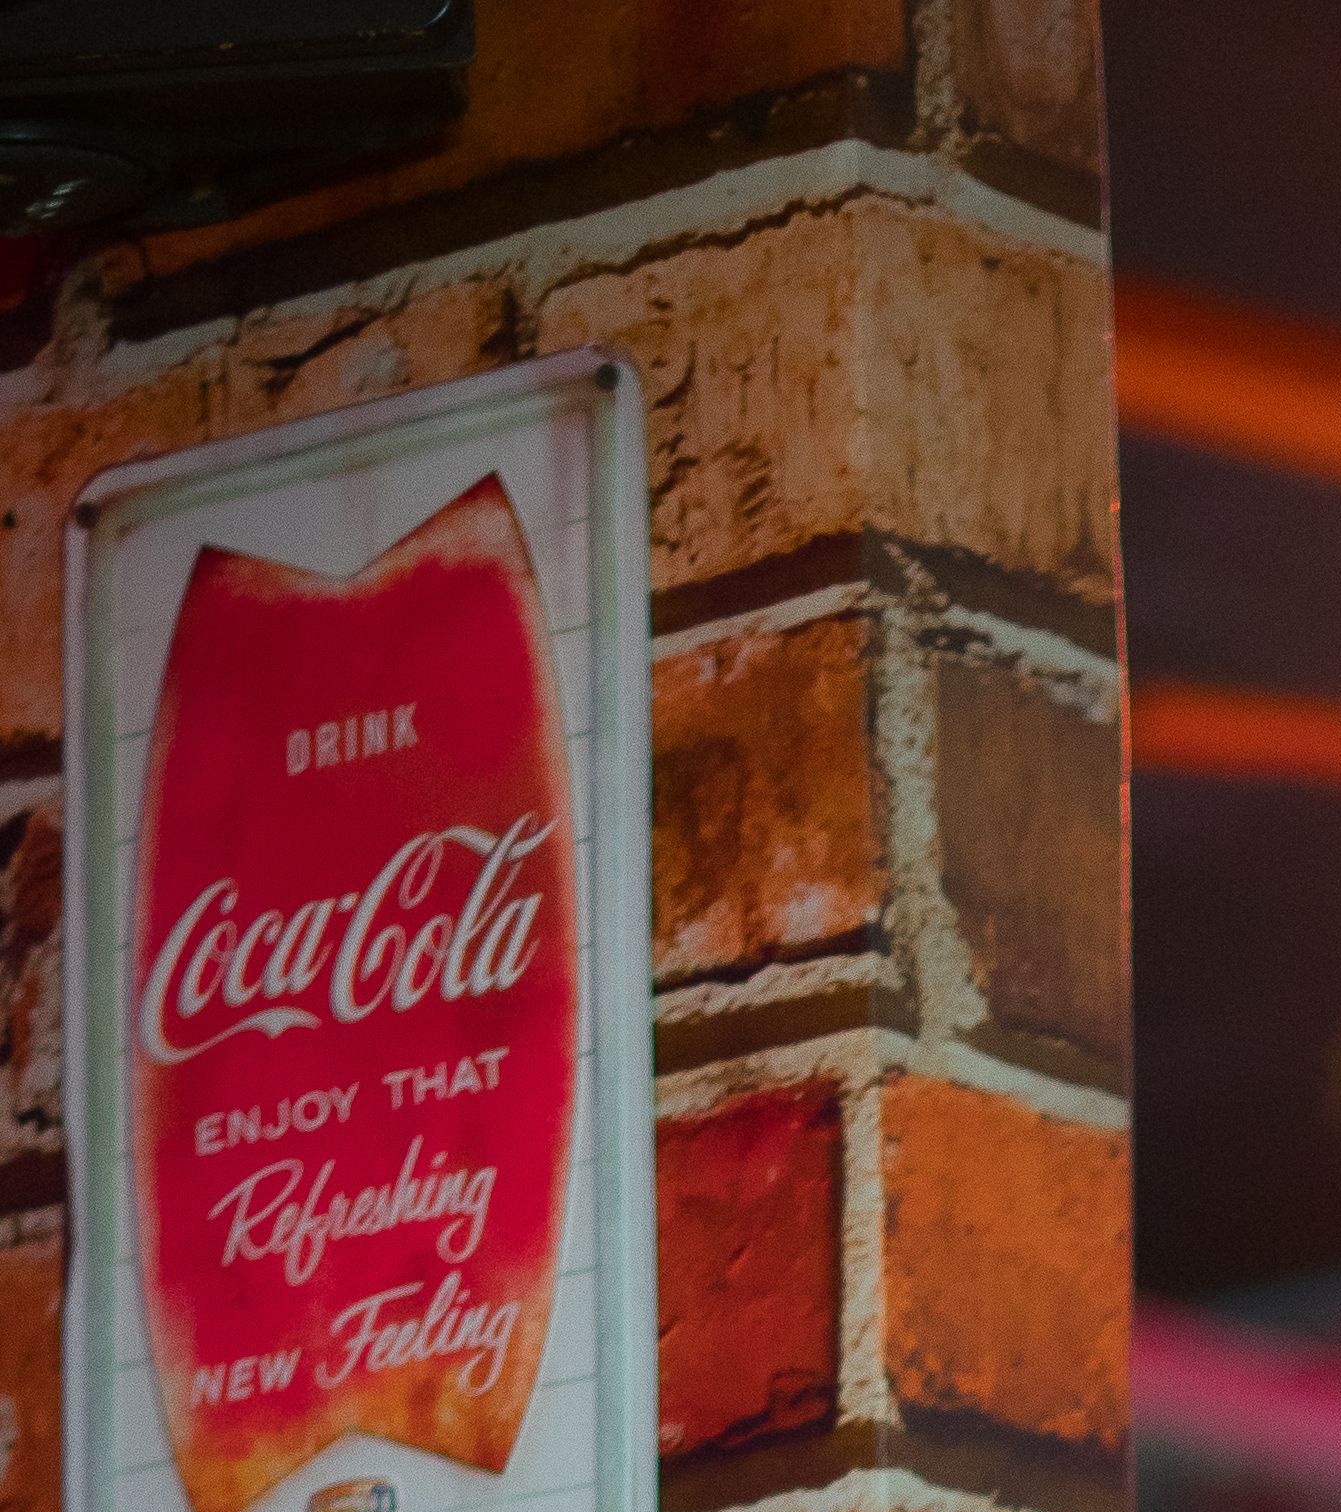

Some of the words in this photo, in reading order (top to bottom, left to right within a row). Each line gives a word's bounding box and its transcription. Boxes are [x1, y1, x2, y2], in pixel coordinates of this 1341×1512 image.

[286, 704, 418, 776] DRINK
[195, 1082, 360, 1156] ENJOY
[383, 1047, 509, 1110] THAT
[208, 1135, 498, 1286] Refreshing
[191, 1350, 301, 1406] NEW
[313, 1272, 521, 1396] Feeling
